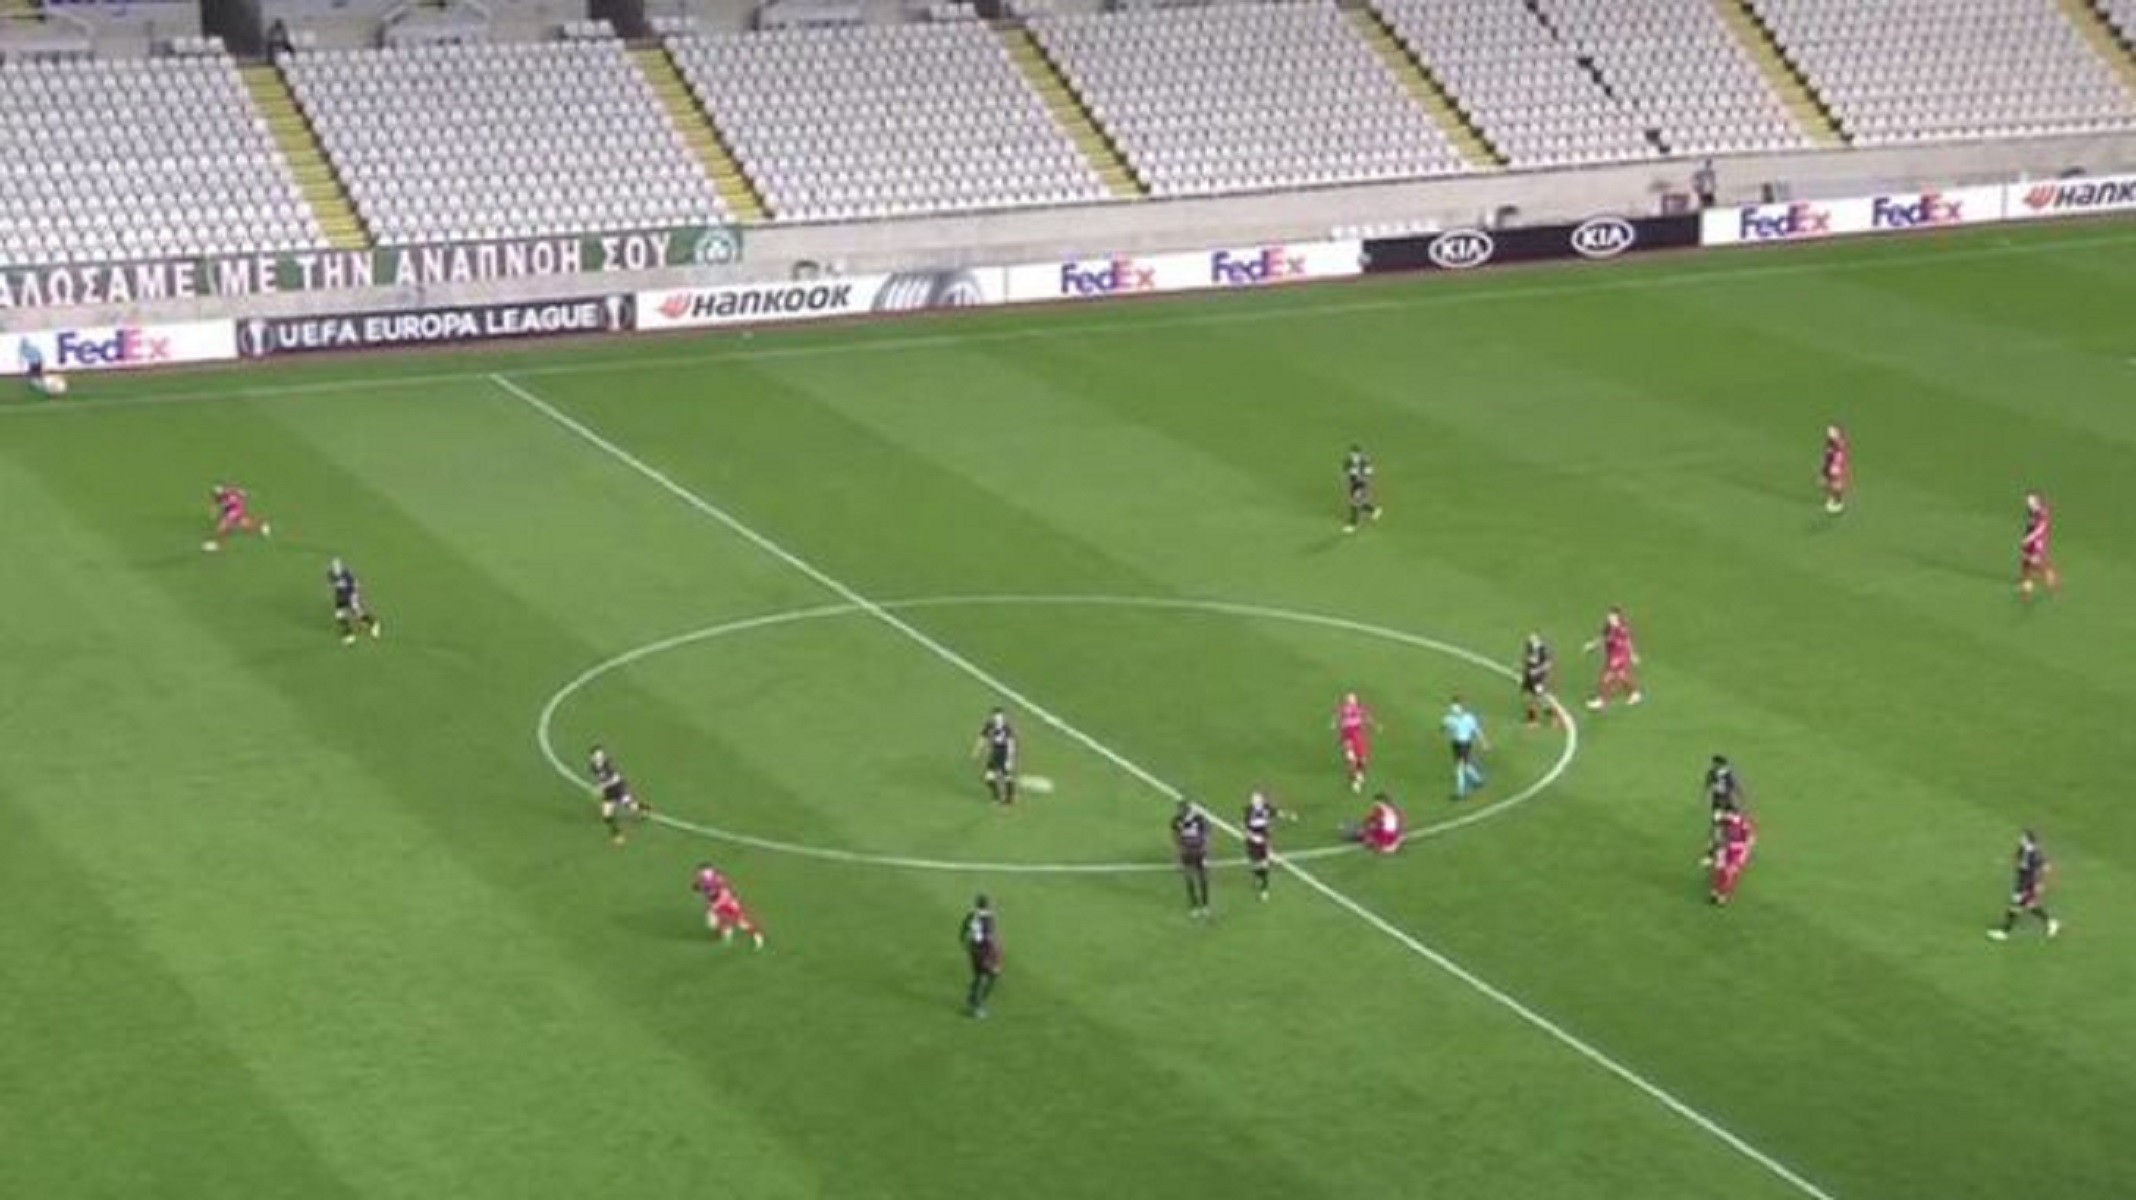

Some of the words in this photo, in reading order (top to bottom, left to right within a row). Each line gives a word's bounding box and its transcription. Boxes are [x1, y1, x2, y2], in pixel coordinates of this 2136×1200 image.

[1740, 204, 1830, 238] FedEx
[1872, 193, 1962, 227] FedEx
[1440, 240, 1480, 261] KIA
[1583, 227, 1623, 249] KIA
[220, 256, 277, 297] ΜΕ
[297, 252, 374, 289] ΤΗΝ
[395, 239, 581, 284] ΑΝΑΠΝΟΗ
[601, 233, 671, 272] ΣΟΥ
[1061, 257, 1155, 294] FedEx
[1211, 246, 1305, 284] FedEx
[278, 322, 356, 346] UEFA
[364, 313, 478, 341] EUROPA
[486, 304, 597, 333] LEAGUE
[58, 330, 169, 364] FedEx
